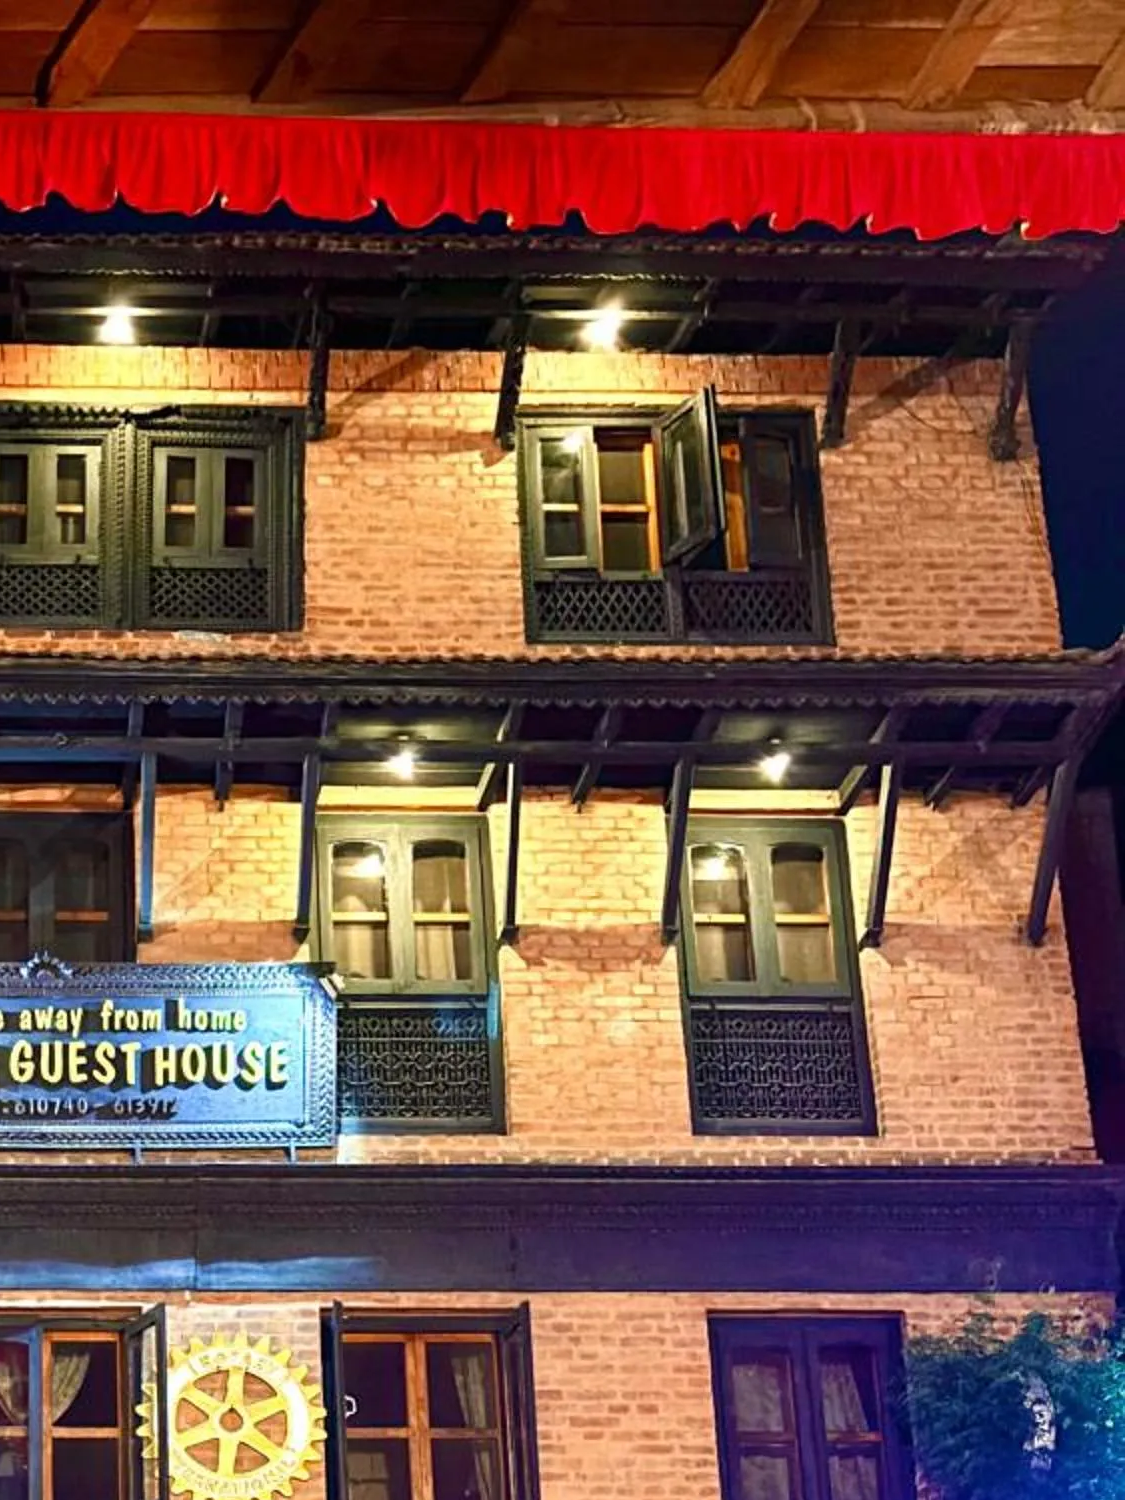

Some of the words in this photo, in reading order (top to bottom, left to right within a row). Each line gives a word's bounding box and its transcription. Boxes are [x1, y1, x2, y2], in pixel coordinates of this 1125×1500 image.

[18, 1007, 84, 1038] away
[100, 999, 162, 1031] from
[177, 996, 248, 1031] home
[9, 1039, 142, 1085] GUEST
[154, 1041, 291, 1086] HOUSE
